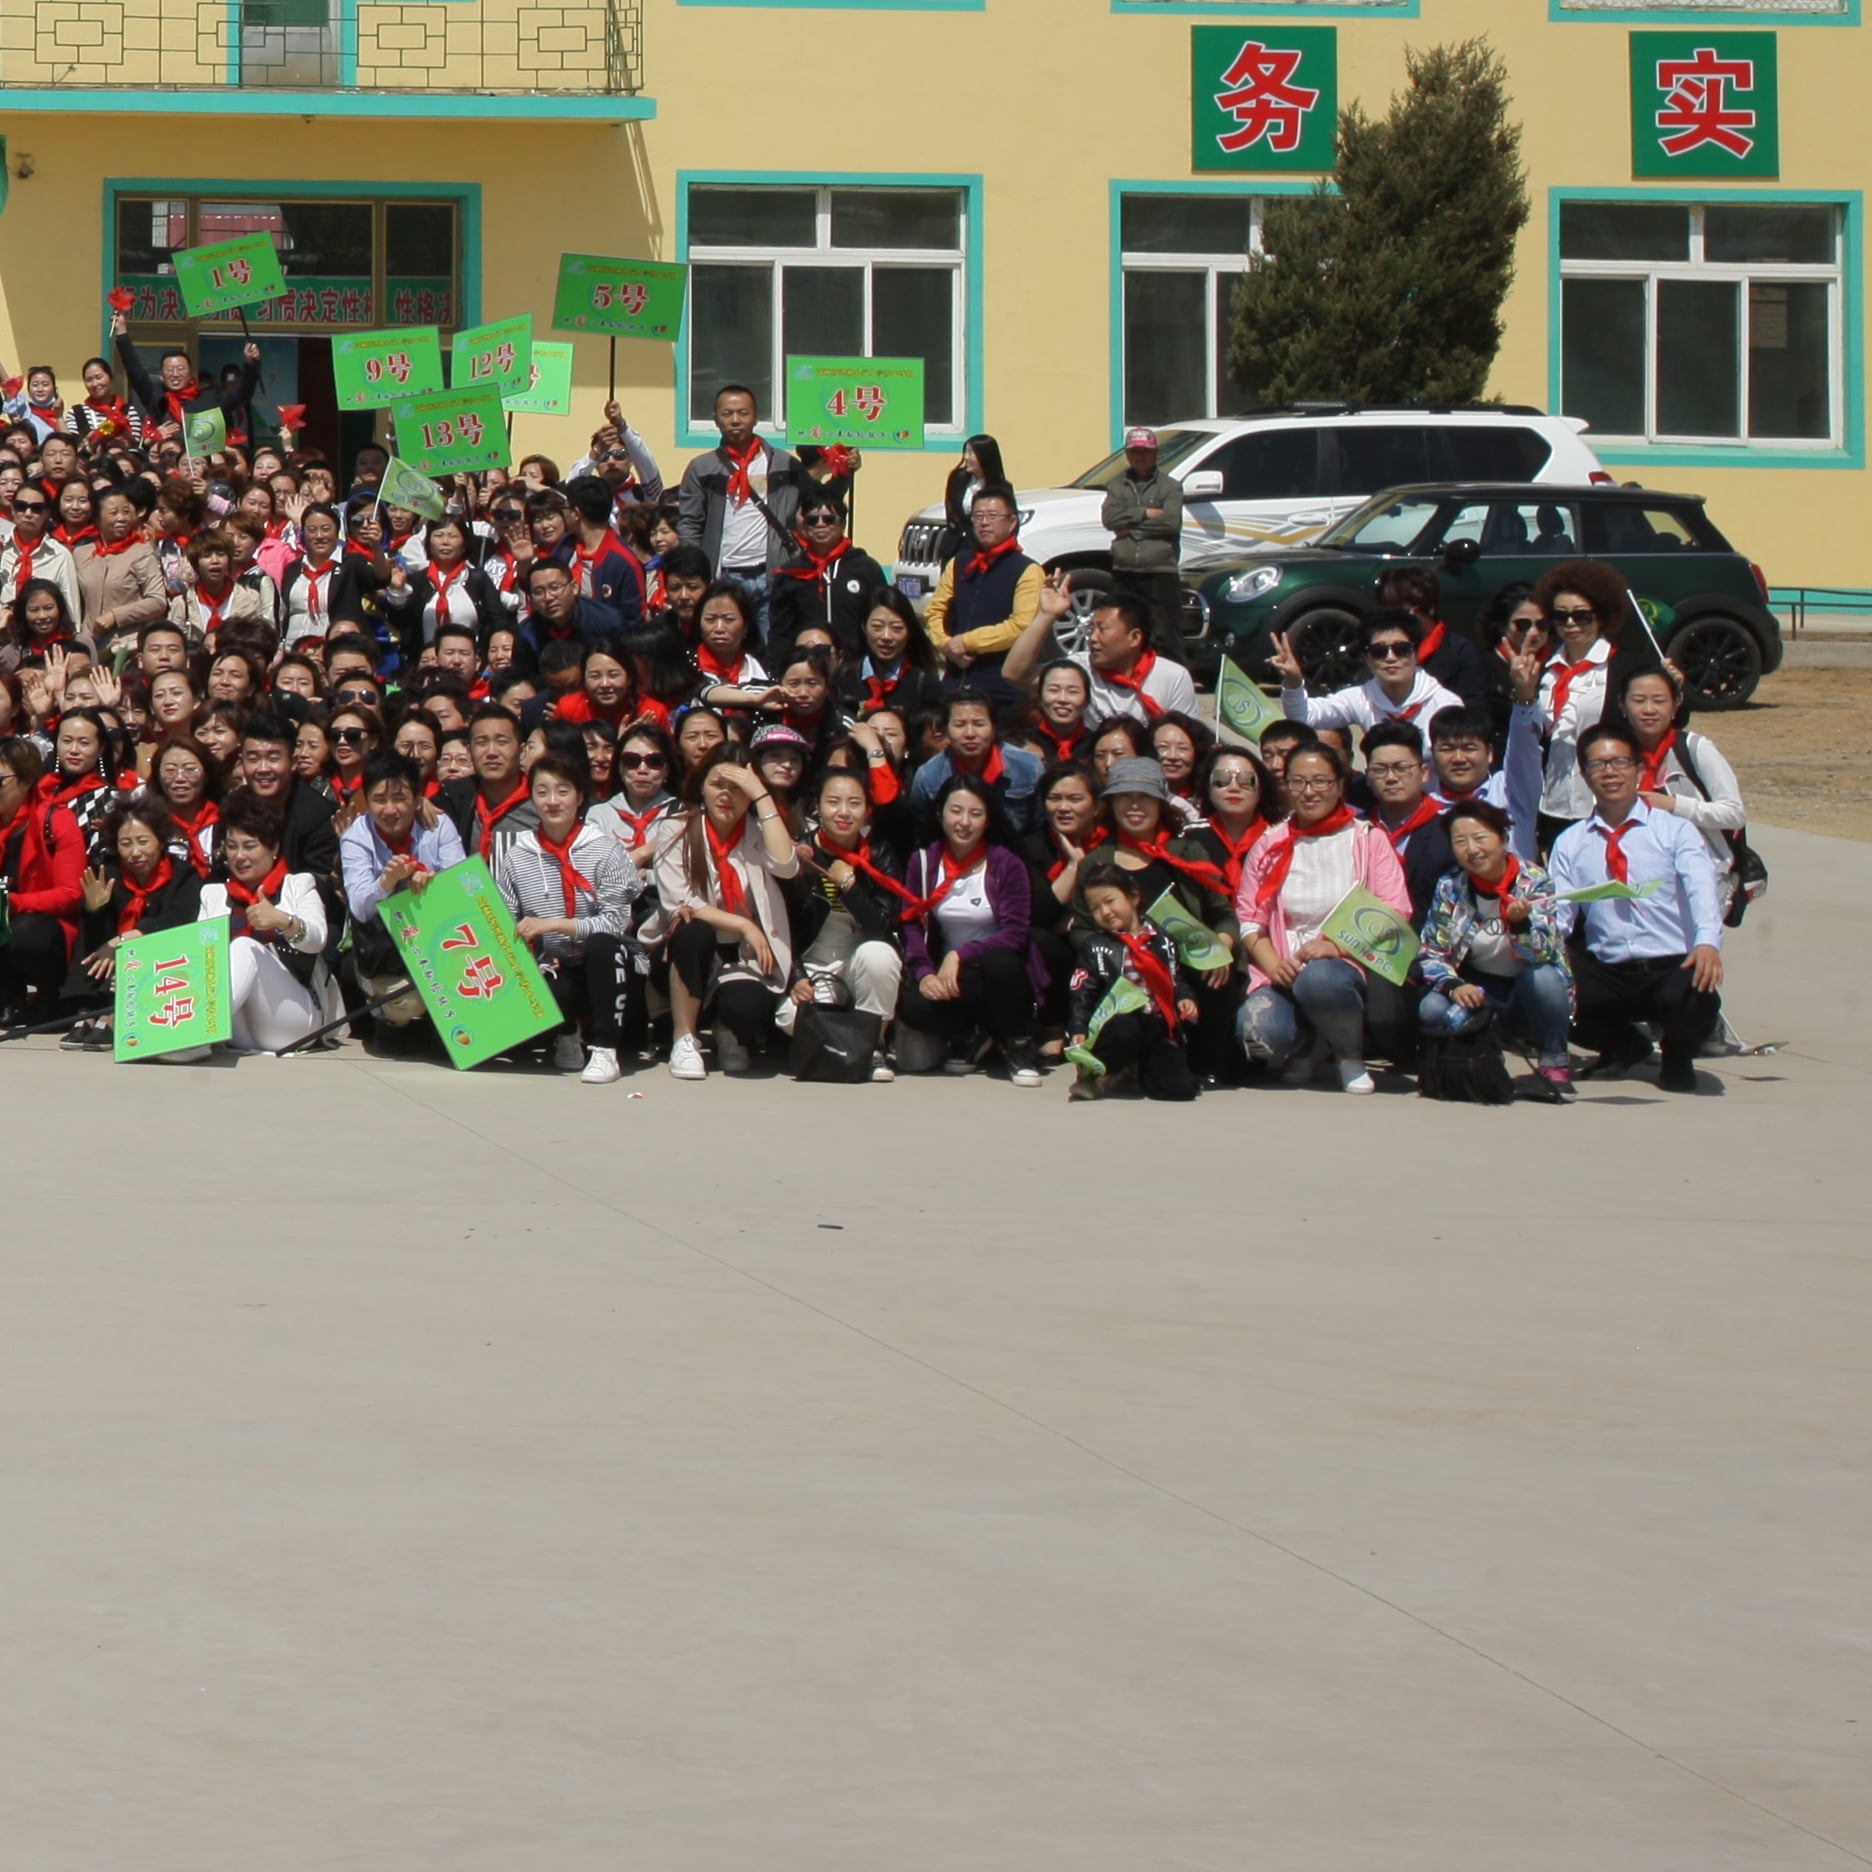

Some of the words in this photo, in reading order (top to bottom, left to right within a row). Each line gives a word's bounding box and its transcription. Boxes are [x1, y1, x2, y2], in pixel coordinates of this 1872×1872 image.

[1214, 41, 1319, 153] 务
[1655, 48, 1755, 158] 实
[210, 258, 253, 290] 1号
[592, 282, 649, 316] 5号
[365, 351, 411, 384] 9号
[469, 342, 515, 380] 12号
[826, 385, 888, 423] 4号
[419, 412, 486, 451] 13号
[441, 922, 503, 1000] 7号
[148, 953, 195, 1030] 14号
